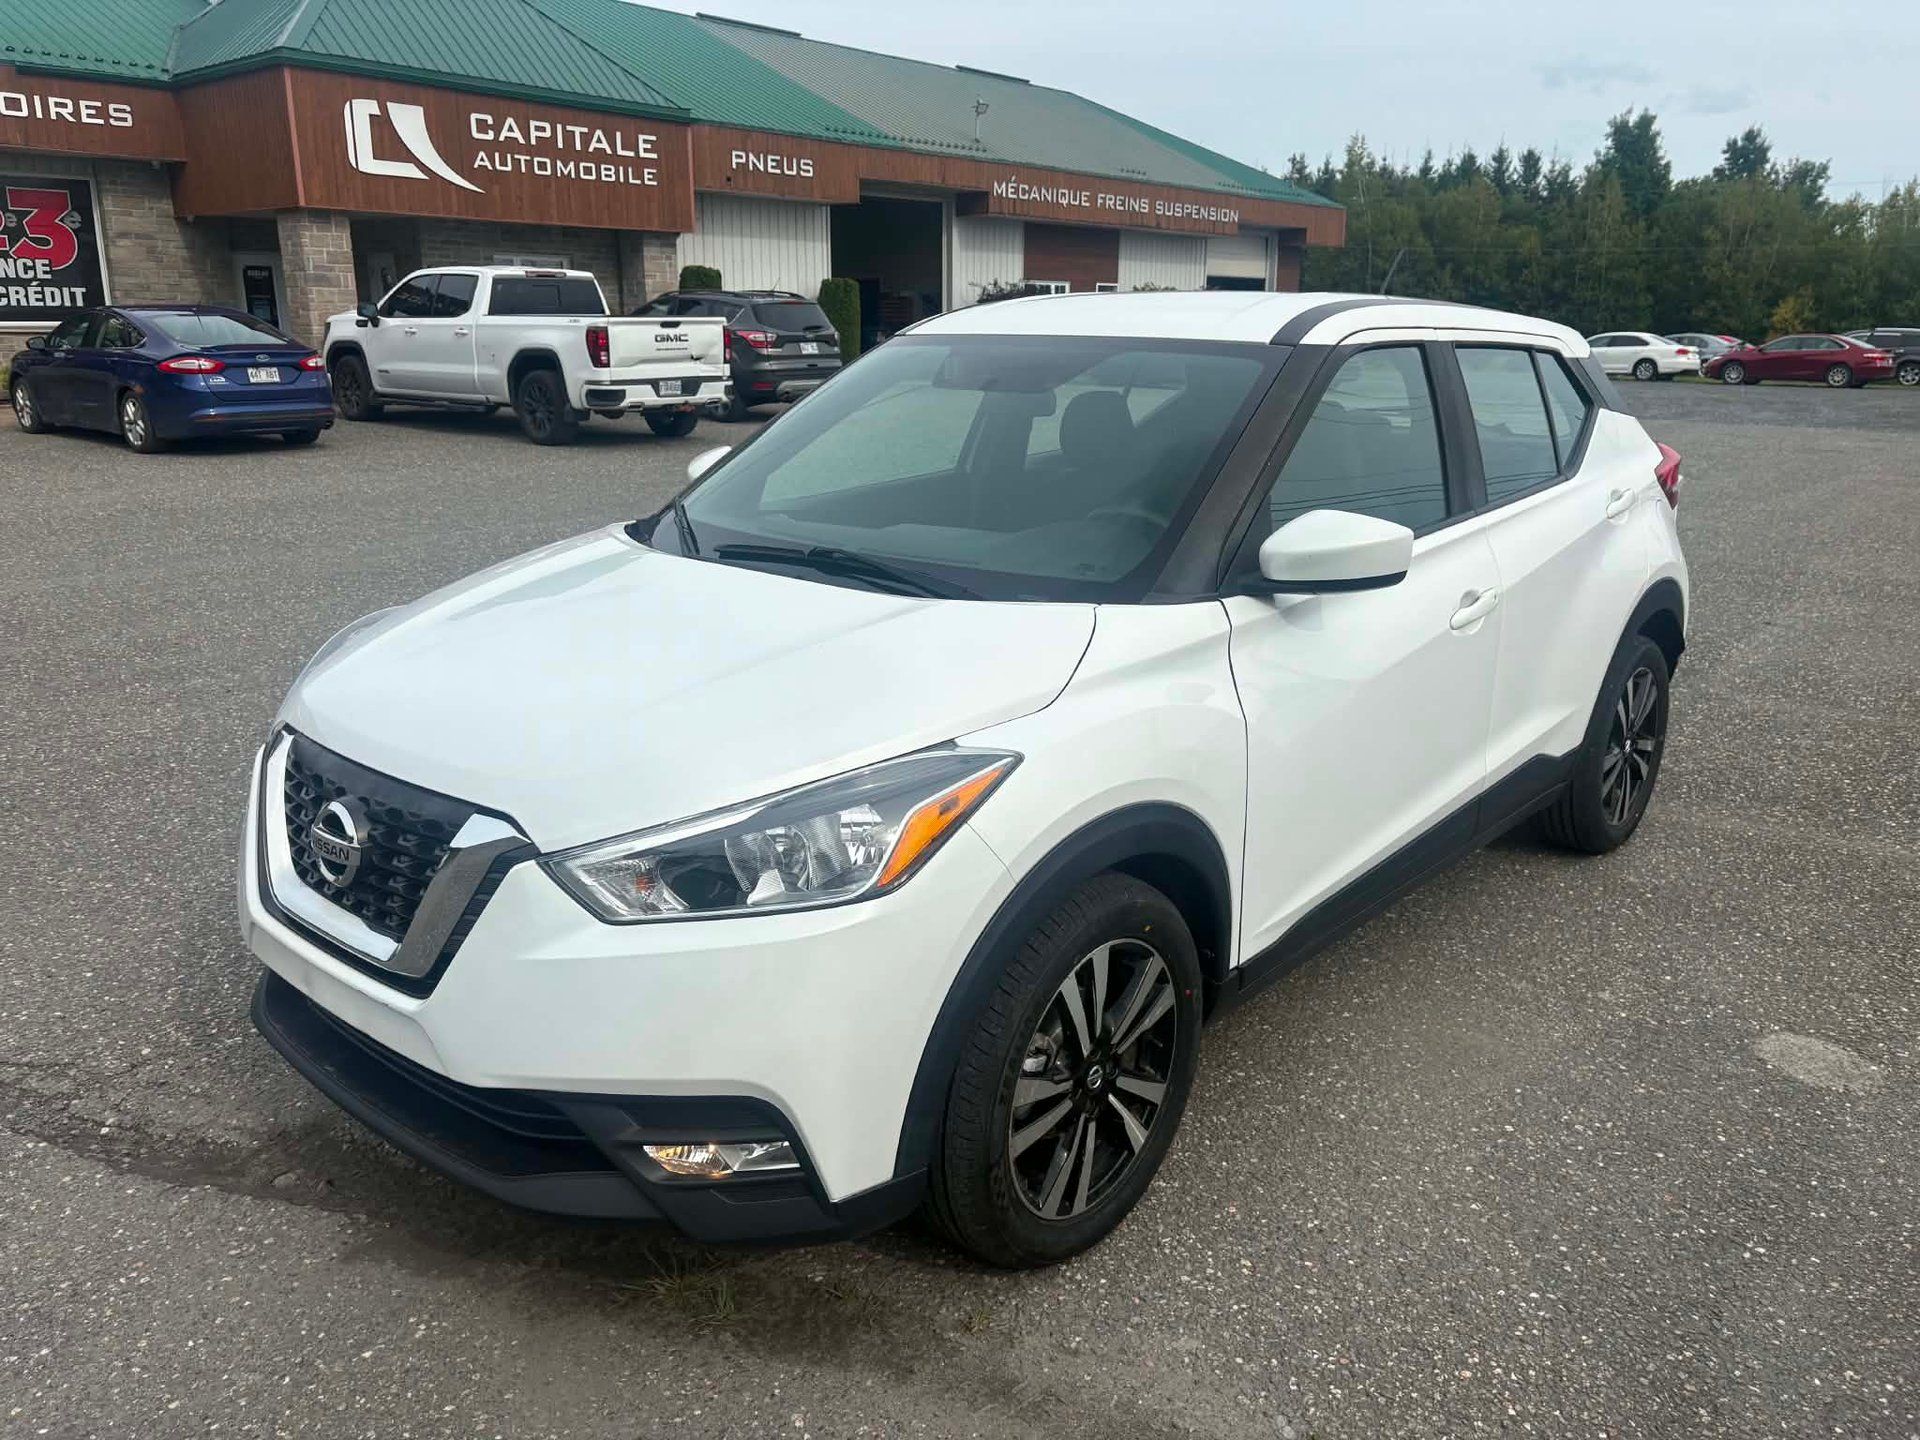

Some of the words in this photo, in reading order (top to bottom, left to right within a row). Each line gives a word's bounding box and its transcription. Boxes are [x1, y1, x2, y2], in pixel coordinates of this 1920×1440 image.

[0, 91, 133, 127] OIRES
[470, 112, 658, 159] CAPITALE
[473, 151, 658, 186] AUTOMOBILE
[731, 150, 814, 178] PNEUS
[993, 175, 1091, 208] MÉCANIQUE
[1097, 193, 1149, 213] FREINS
[1155, 200, 1239, 223] SUSPENSION
[655, 334, 689, 342] GMC
[313, 832, 350, 861] ISSAN
